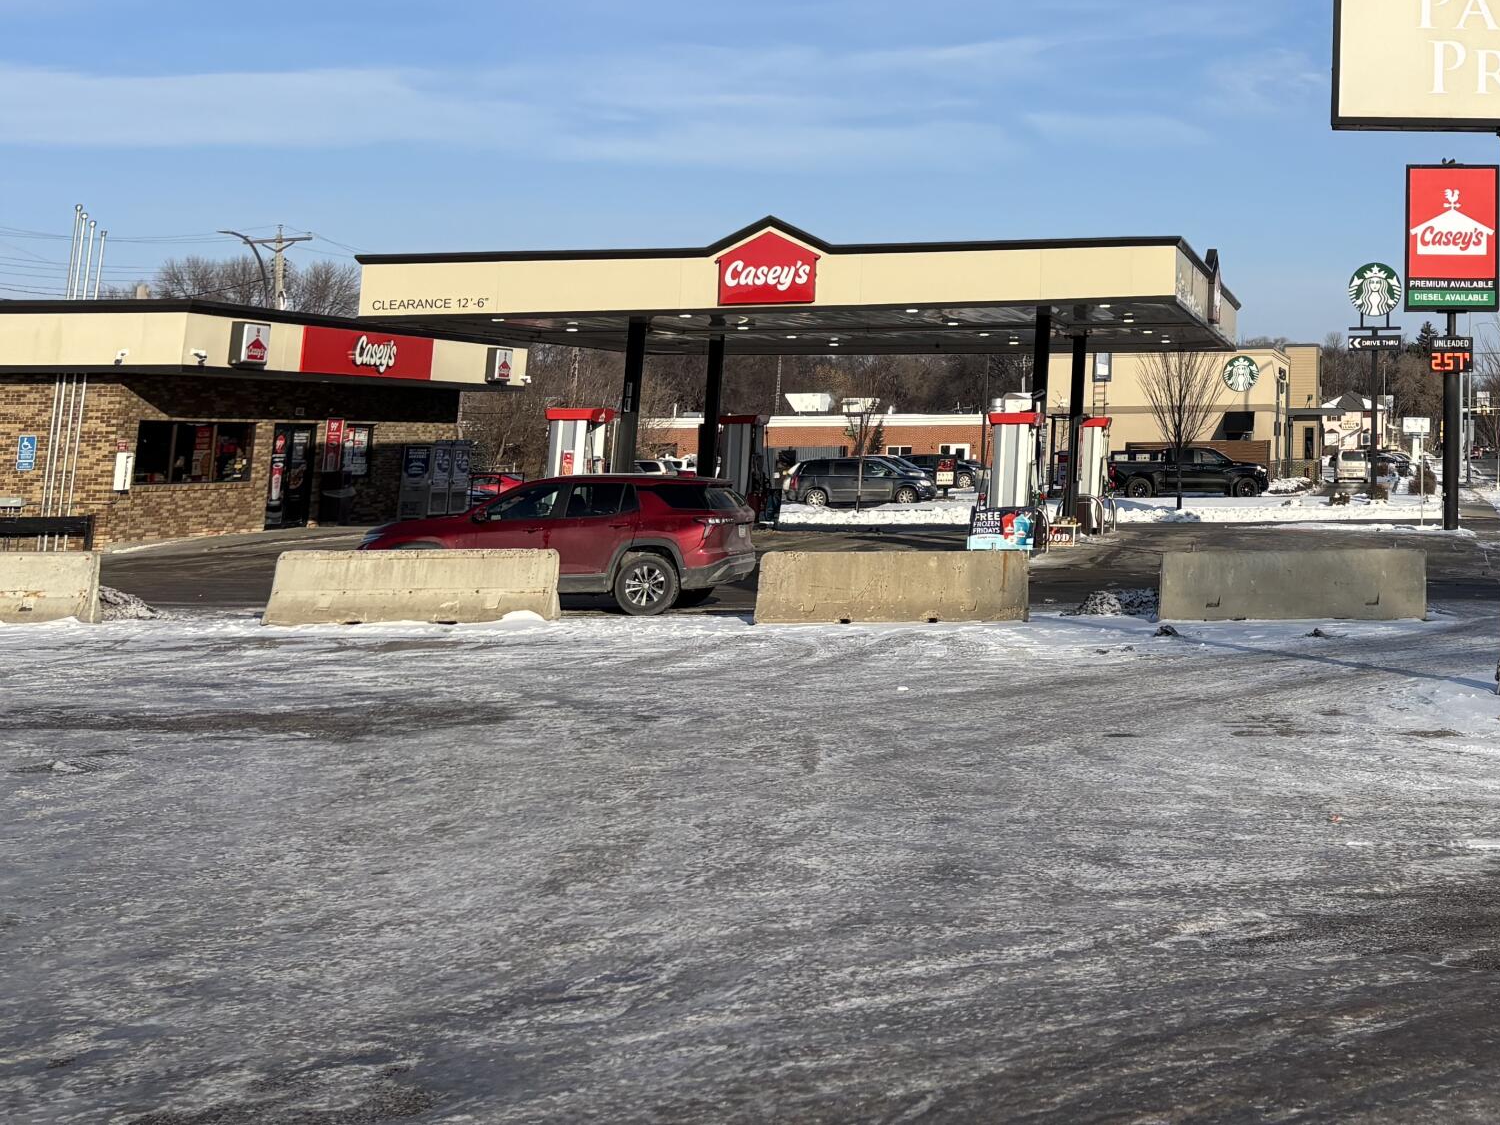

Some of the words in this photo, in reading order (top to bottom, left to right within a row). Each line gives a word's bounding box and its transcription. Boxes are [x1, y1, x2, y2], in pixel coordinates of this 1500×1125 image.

[1420, 225, 1484, 251] Casey's
[724, 260, 811, 291] Casey's
[1409, 280, 1448, 288] PREMIUM
[1414, 293, 1443, 301] DIESEL
[1444, 293, 1489, 302] AVAILABLE
[372, 298, 452, 311] CLEARANCE
[1361, 338, 1381, 346] DRIVE
[1433, 339, 1470, 348] UNLEADED
[355, 335, 398, 373] Casey's
[975, 511, 1001, 521] FREE
[972, 527, 1001, 535] FRIDAYS
